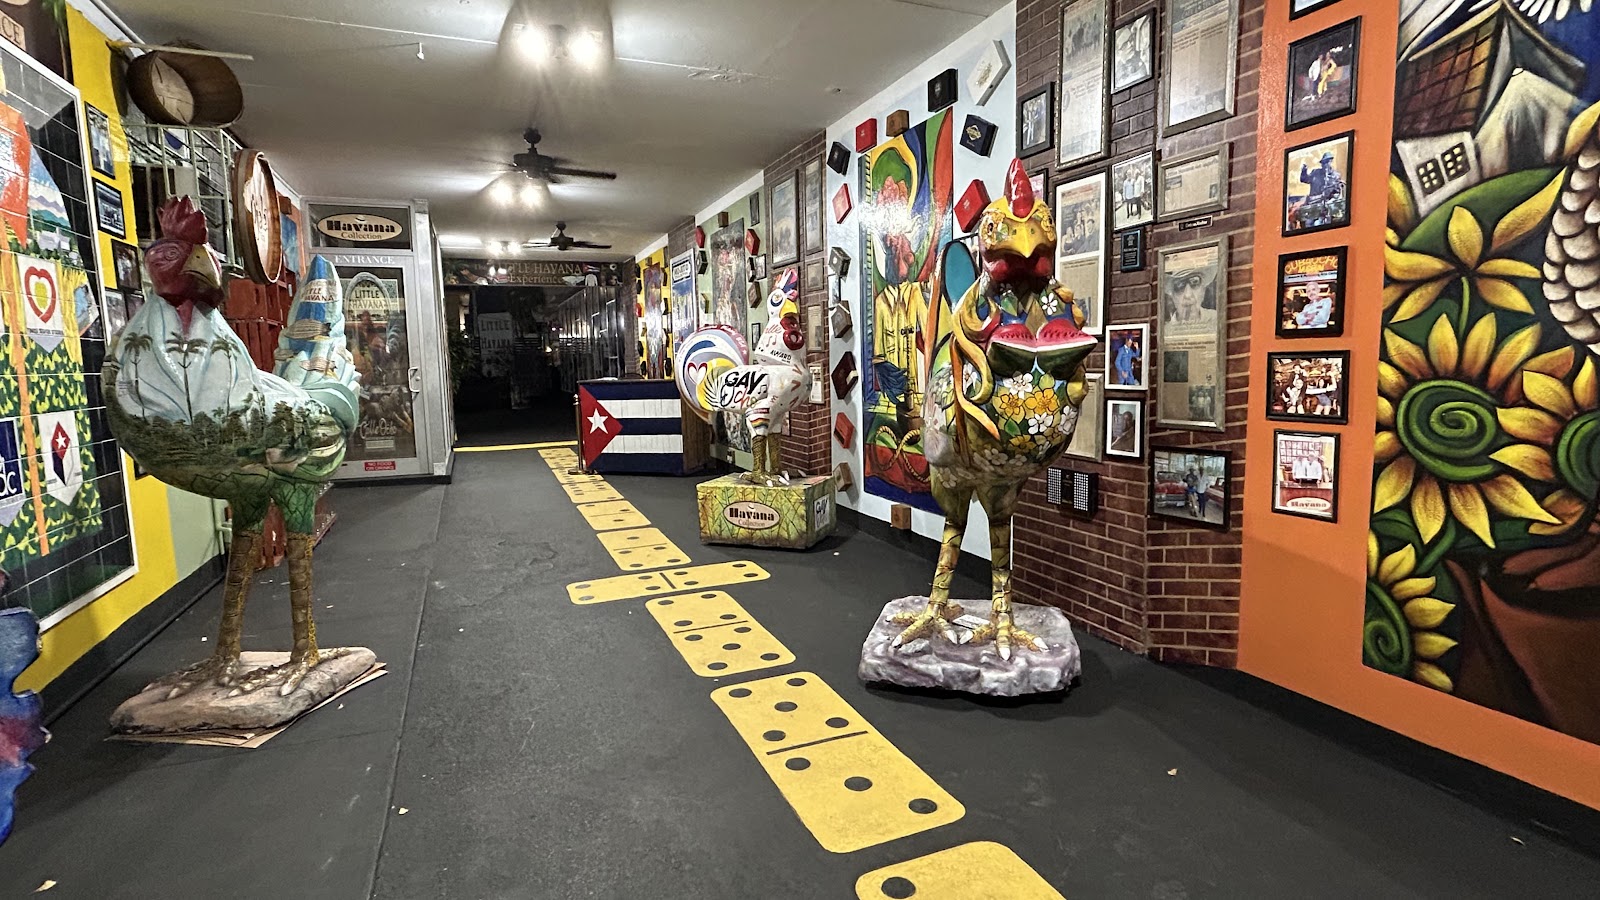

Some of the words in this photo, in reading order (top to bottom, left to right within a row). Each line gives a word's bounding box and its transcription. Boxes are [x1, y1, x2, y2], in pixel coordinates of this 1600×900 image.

[0, 15, 22, 46] CE
[326, 220, 395, 233] Havana
[340, 231, 383, 240] Collection
[335, 255, 396, 265] ENTRANCE
[534, 263, 582, 275] HAVANA
[509, 274, 563, 285] Experience
[354, 289, 380, 299] LITTLE
[352, 299, 384, 309] HAVANA
[481, 319, 510, 331] LITTLE
[765, 324, 782, 334] alle
[724, 371, 769, 395] GAY
[729, 507, 775, 521] Havana
